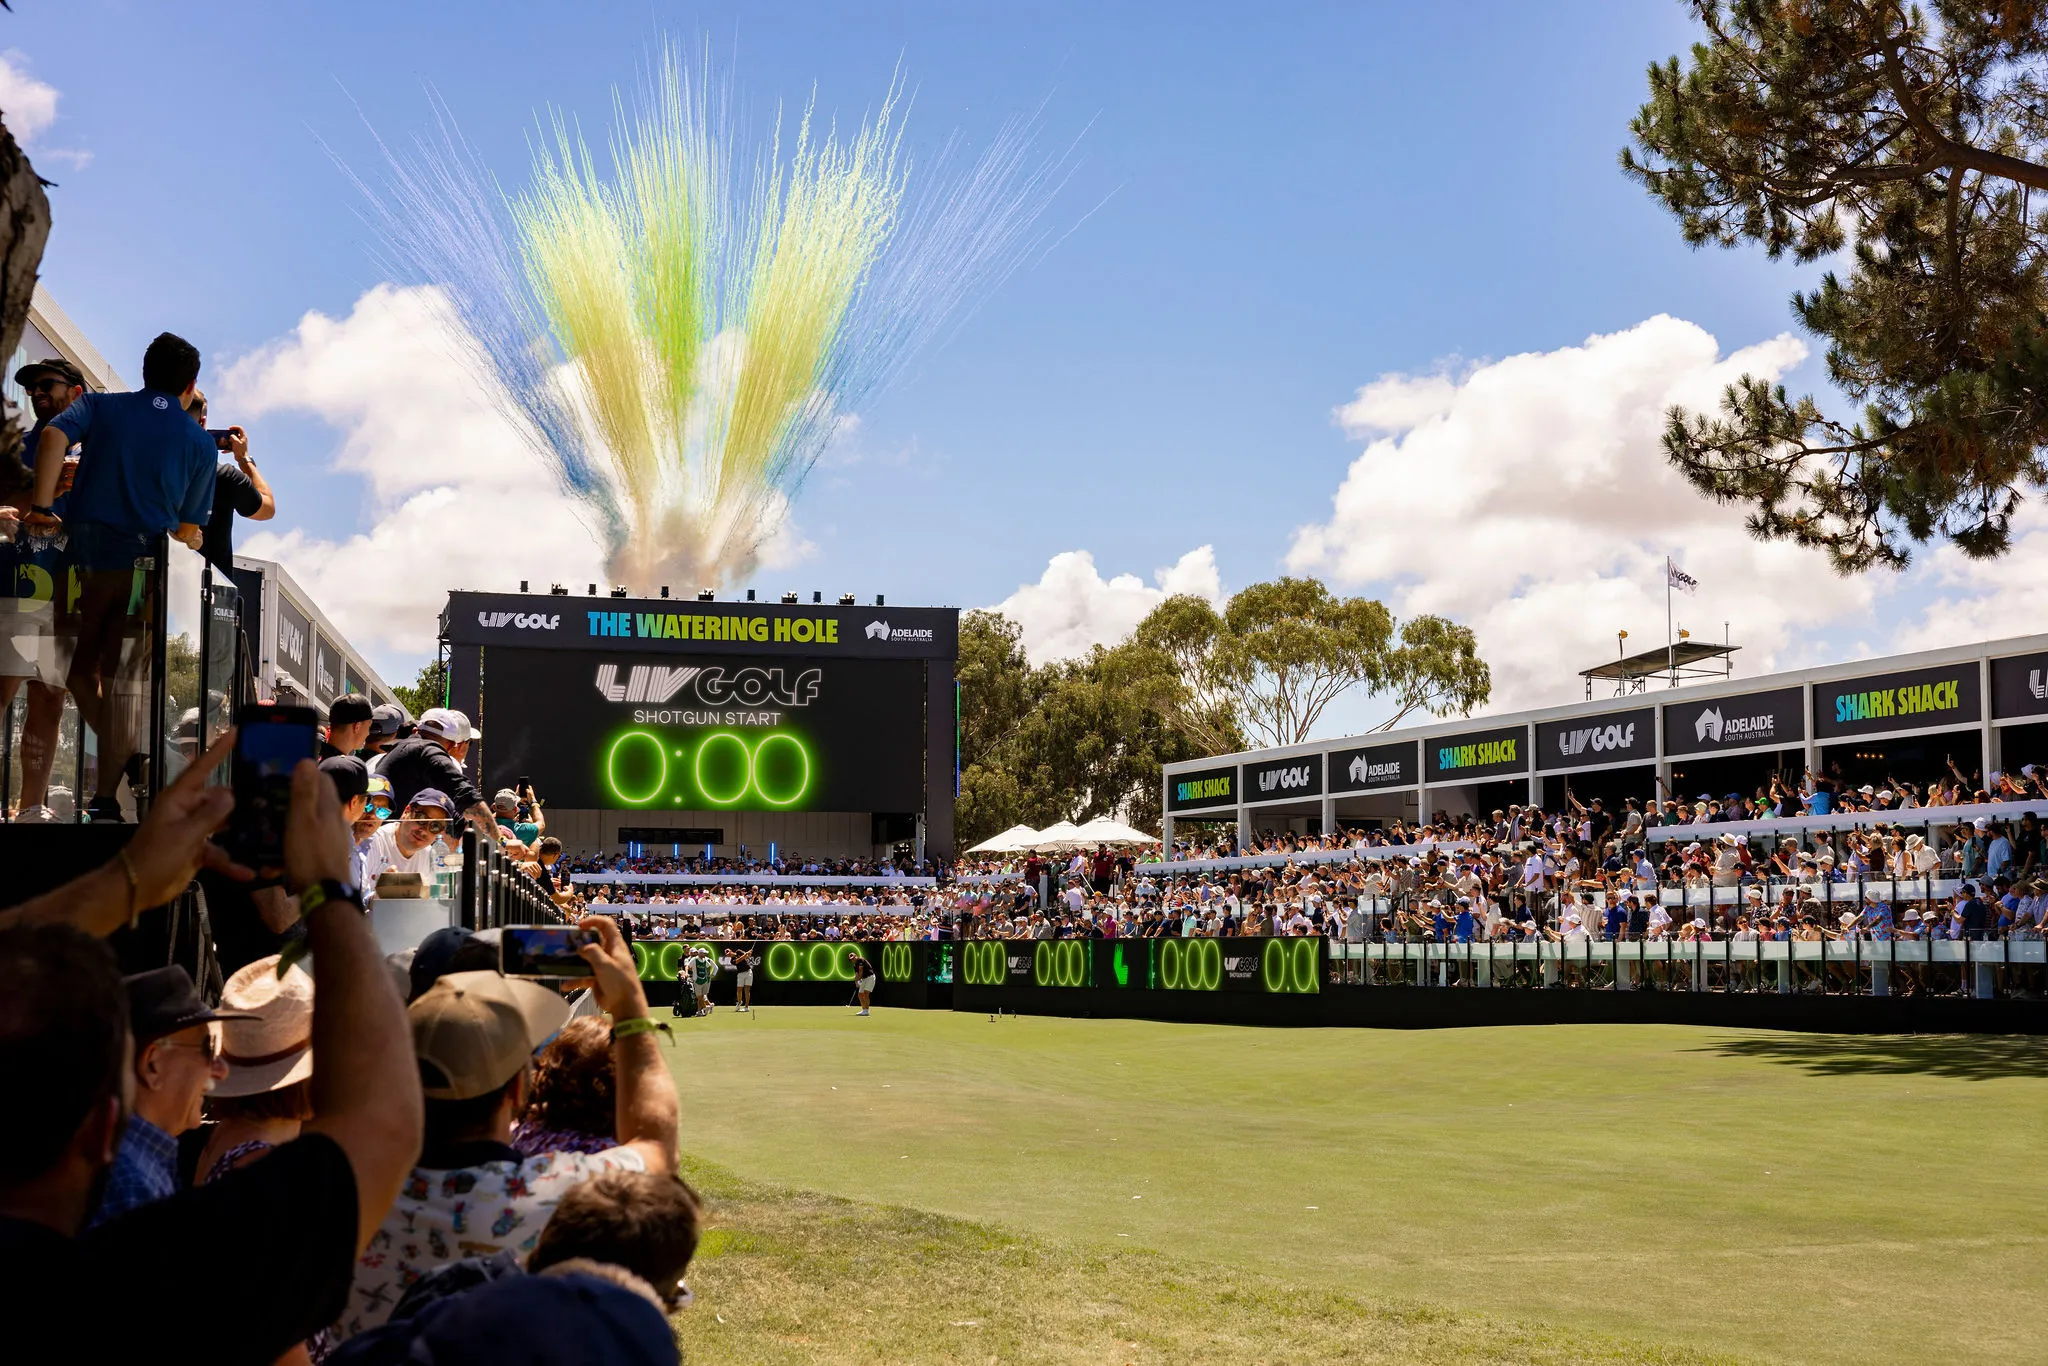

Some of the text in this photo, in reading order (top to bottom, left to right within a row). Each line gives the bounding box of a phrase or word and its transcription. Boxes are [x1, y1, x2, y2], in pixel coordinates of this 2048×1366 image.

[478, 611, 560, 630] LIV GOLF
[587, 611, 839, 643] THE WATERING HOLE
[891, 628, 933, 638] ADELAIDE
[596, 664, 822, 706] LIV GOLF
[2028, 669, 2048, 699] L
[1836, 680, 1959, 723] SHARK SHACK
[633, 709, 782, 726] SHOTGUN START
[1724, 714, 1774, 734] ADELAIDE
[1558, 722, 1635, 756] LIV GOLF
[1724, 730, 1775, 742] SOUTH AUSTRALIA
[608, 731, 809, 805] 0:00
[1368, 762, 1400, 776] ADELAIDE
[1439, 739, 1516, 770] SHARK SHACK
[1177, 776, 1230, 801] SHARK SHACK
[1258, 765, 1310, 792] LIV GOLF
[883, 945, 911, 978] 0:00
[964, 942, 1005, 983] 0:00
[1036, 941, 1083, 985] 0:00
[1162, 940, 1220, 989] 0:00
